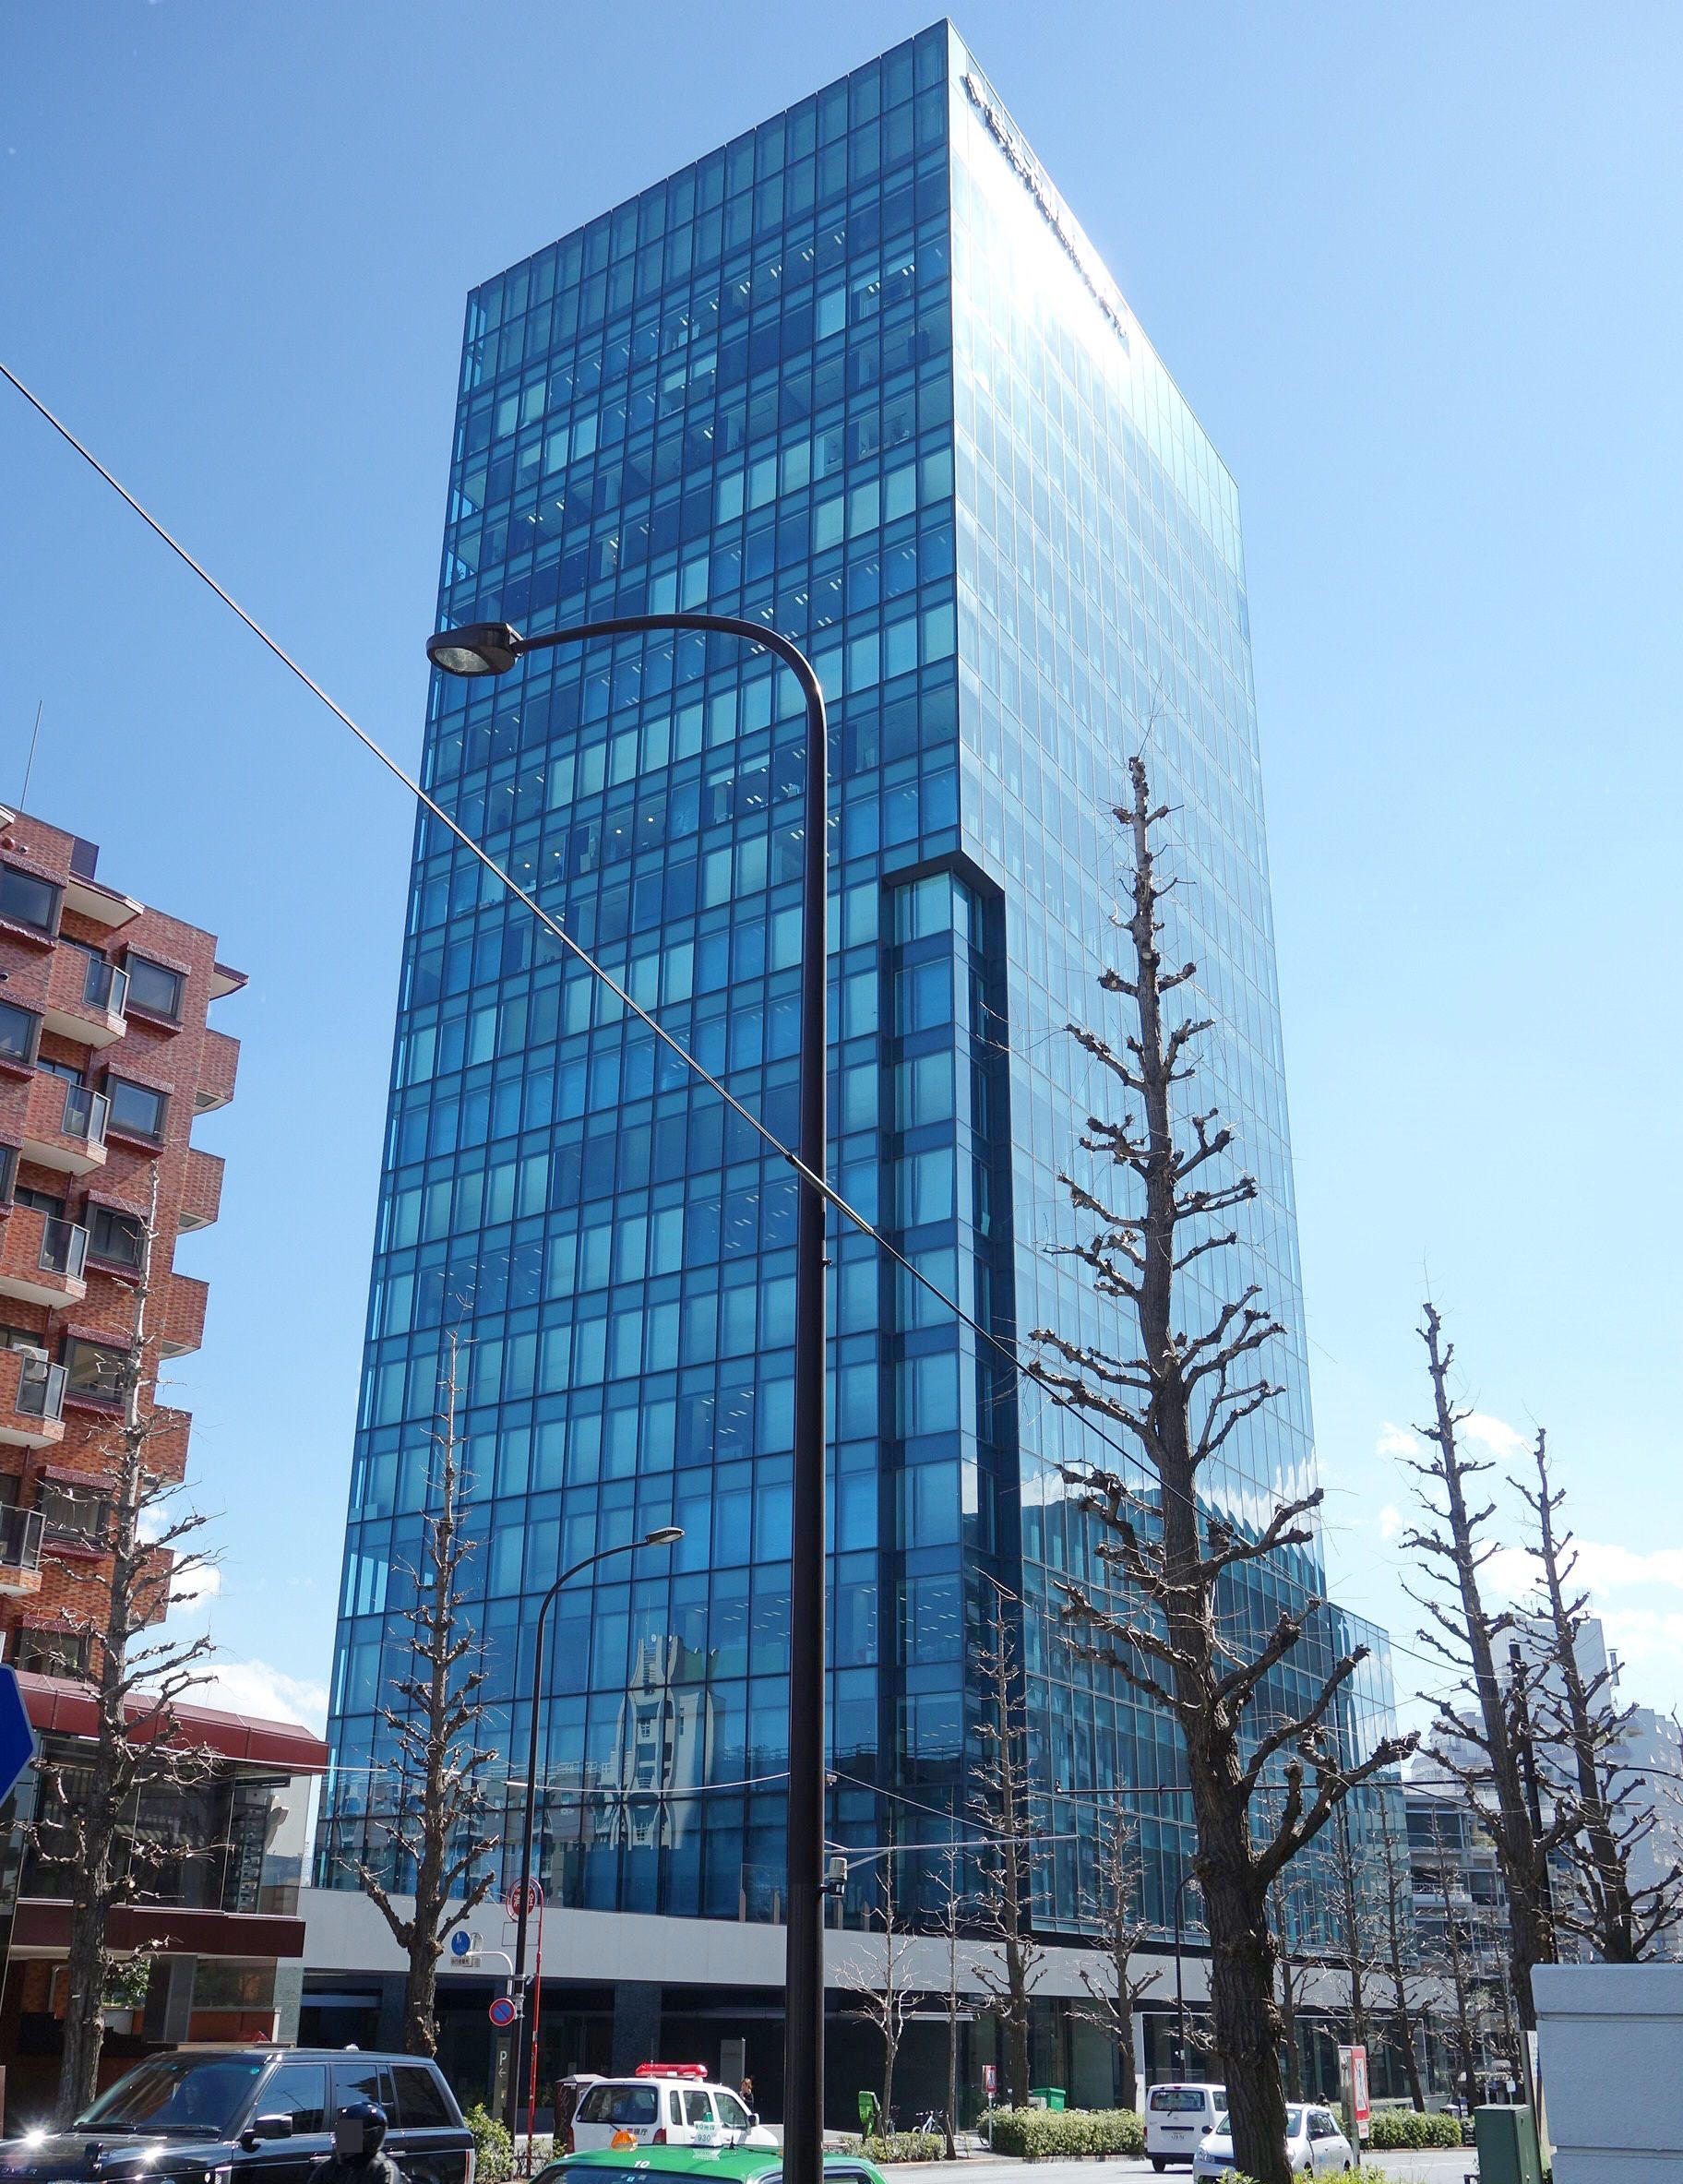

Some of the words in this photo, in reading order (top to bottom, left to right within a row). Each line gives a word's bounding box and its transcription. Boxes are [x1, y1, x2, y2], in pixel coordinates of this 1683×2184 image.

[499, 2050, 507, 2066] P
[698, 2133, 711, 2142] 930
[634, 2160, 651, 2168] 10
